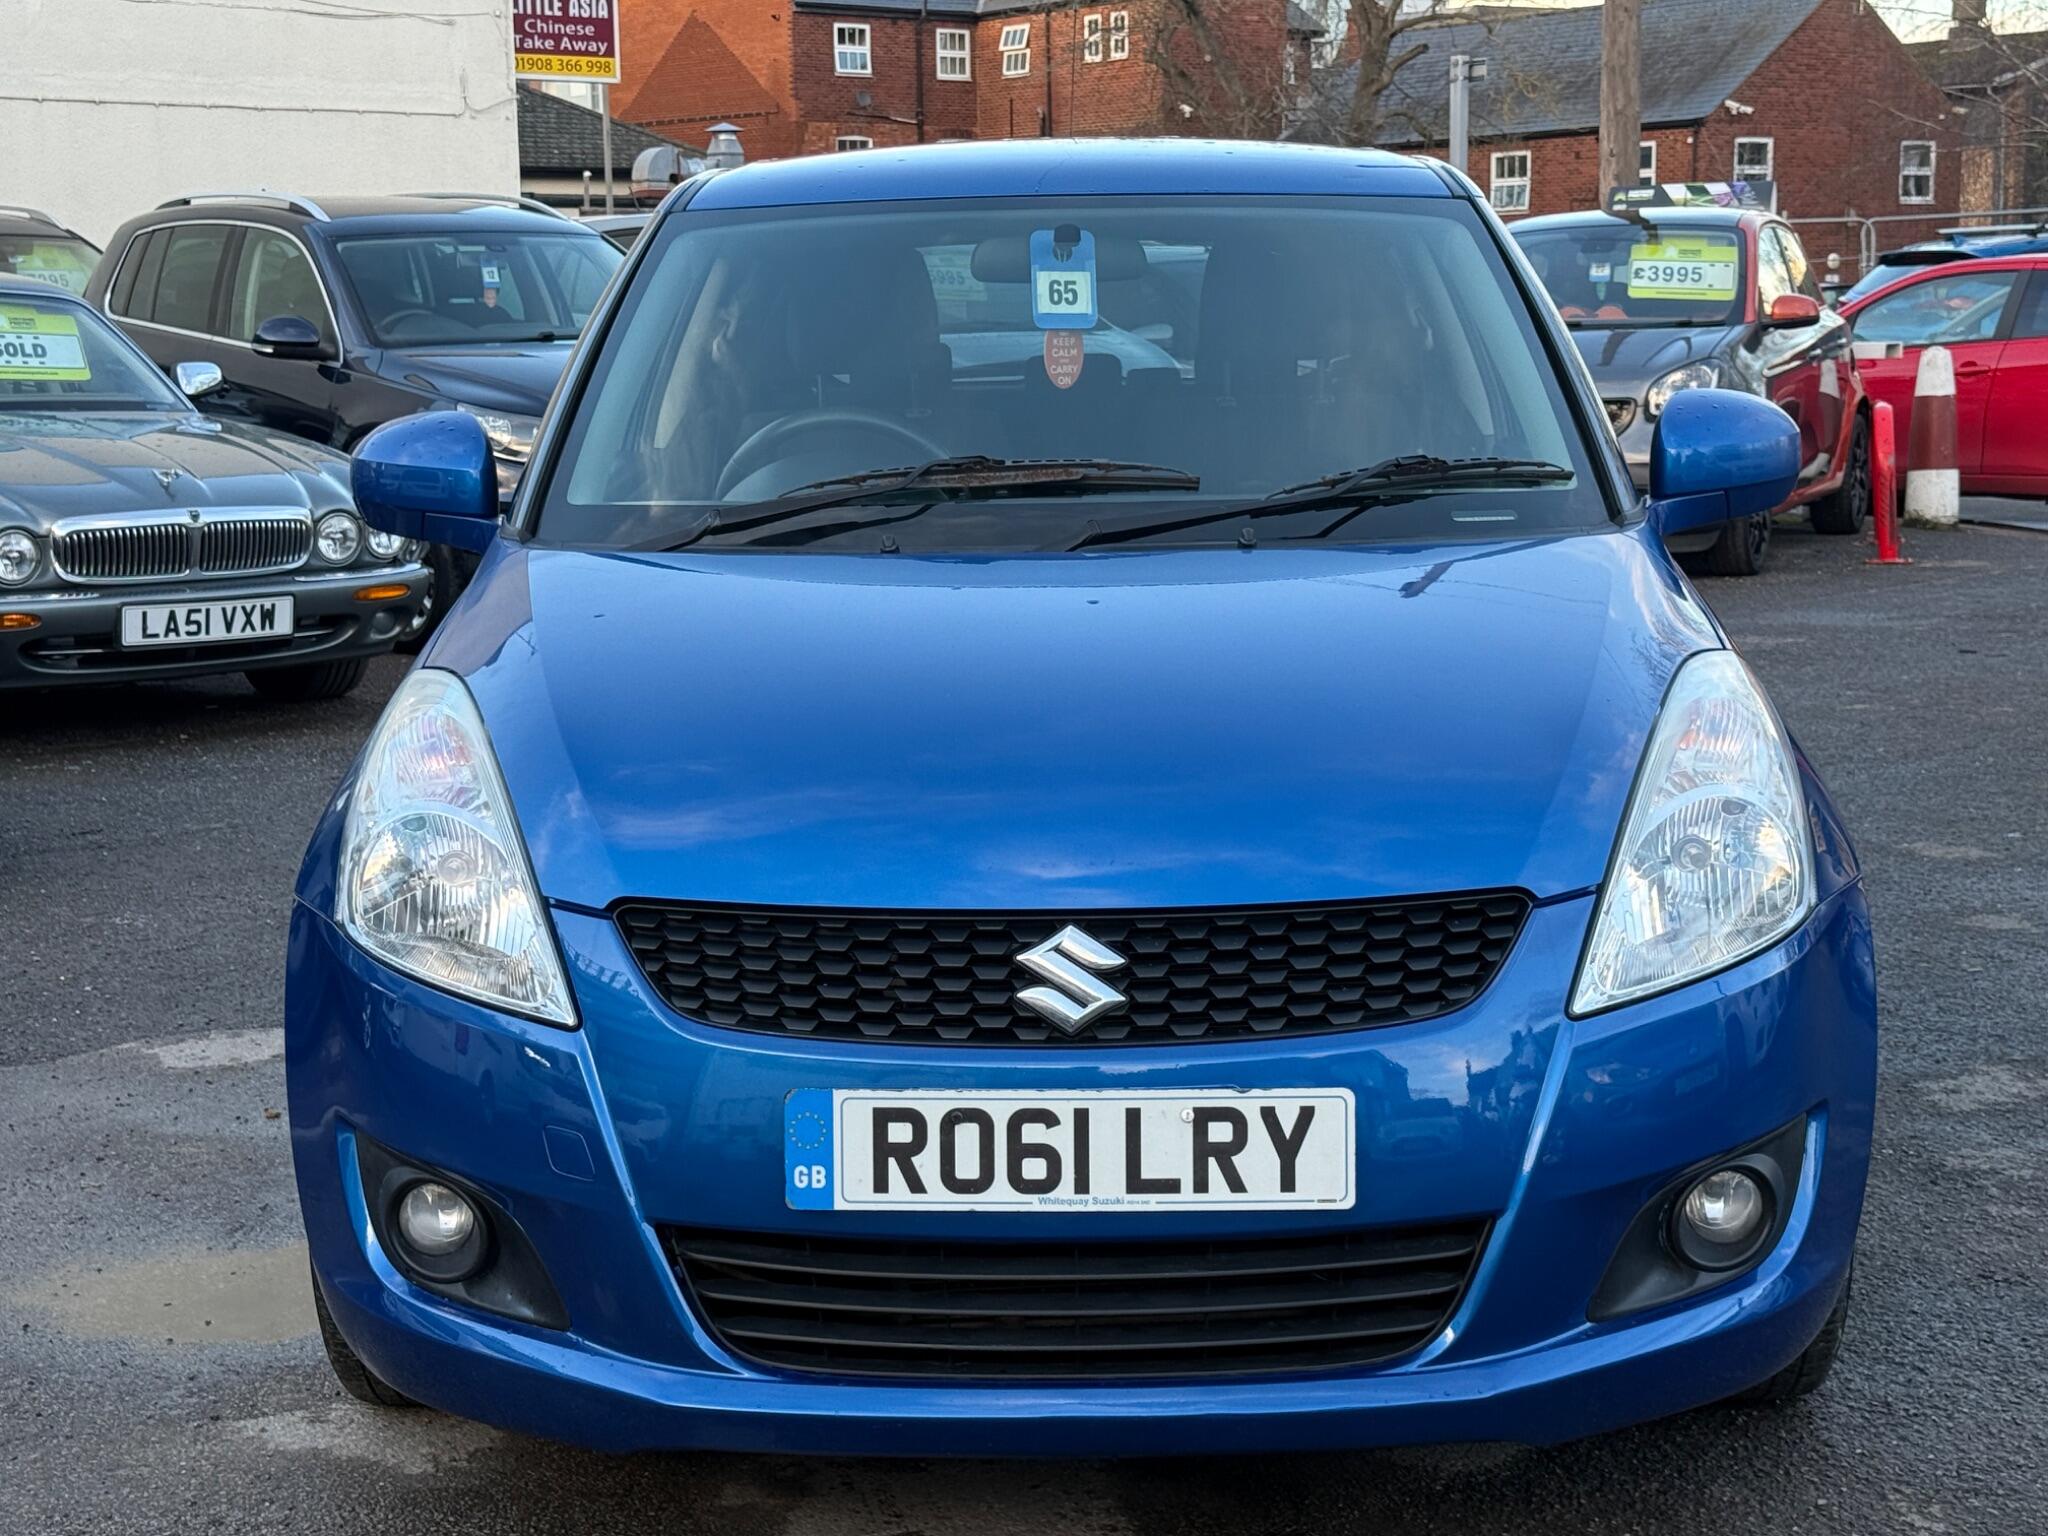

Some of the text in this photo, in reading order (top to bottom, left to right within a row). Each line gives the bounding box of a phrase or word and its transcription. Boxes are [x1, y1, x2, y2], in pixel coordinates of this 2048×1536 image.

[513, 0, 609, 19] ITTLE ASIA
[524, 18, 596, 36] Chinese
[514, 34, 608, 56] Take Away
[557, 58, 583, 73] 366
[585, 60, 612, 74] 998
[1633, 265, 1703, 283] £3995
[1048, 279, 1078, 306] 65
[1053, 336, 1076, 346] KEEP
[1051, 347, 1078, 357] CALM
[1050, 364, 1078, 374] CARRY
[1057, 375, 1072, 385] ON
[142, 602, 276, 640] LA51 VXW
[871, 1105, 1316, 1195] RO61 LRY
[794, 1164, 827, 1189] GB
[1037, 1196, 1090, 1207] Whitequay
[1091, 1196, 1125, 1206] Suzuki
